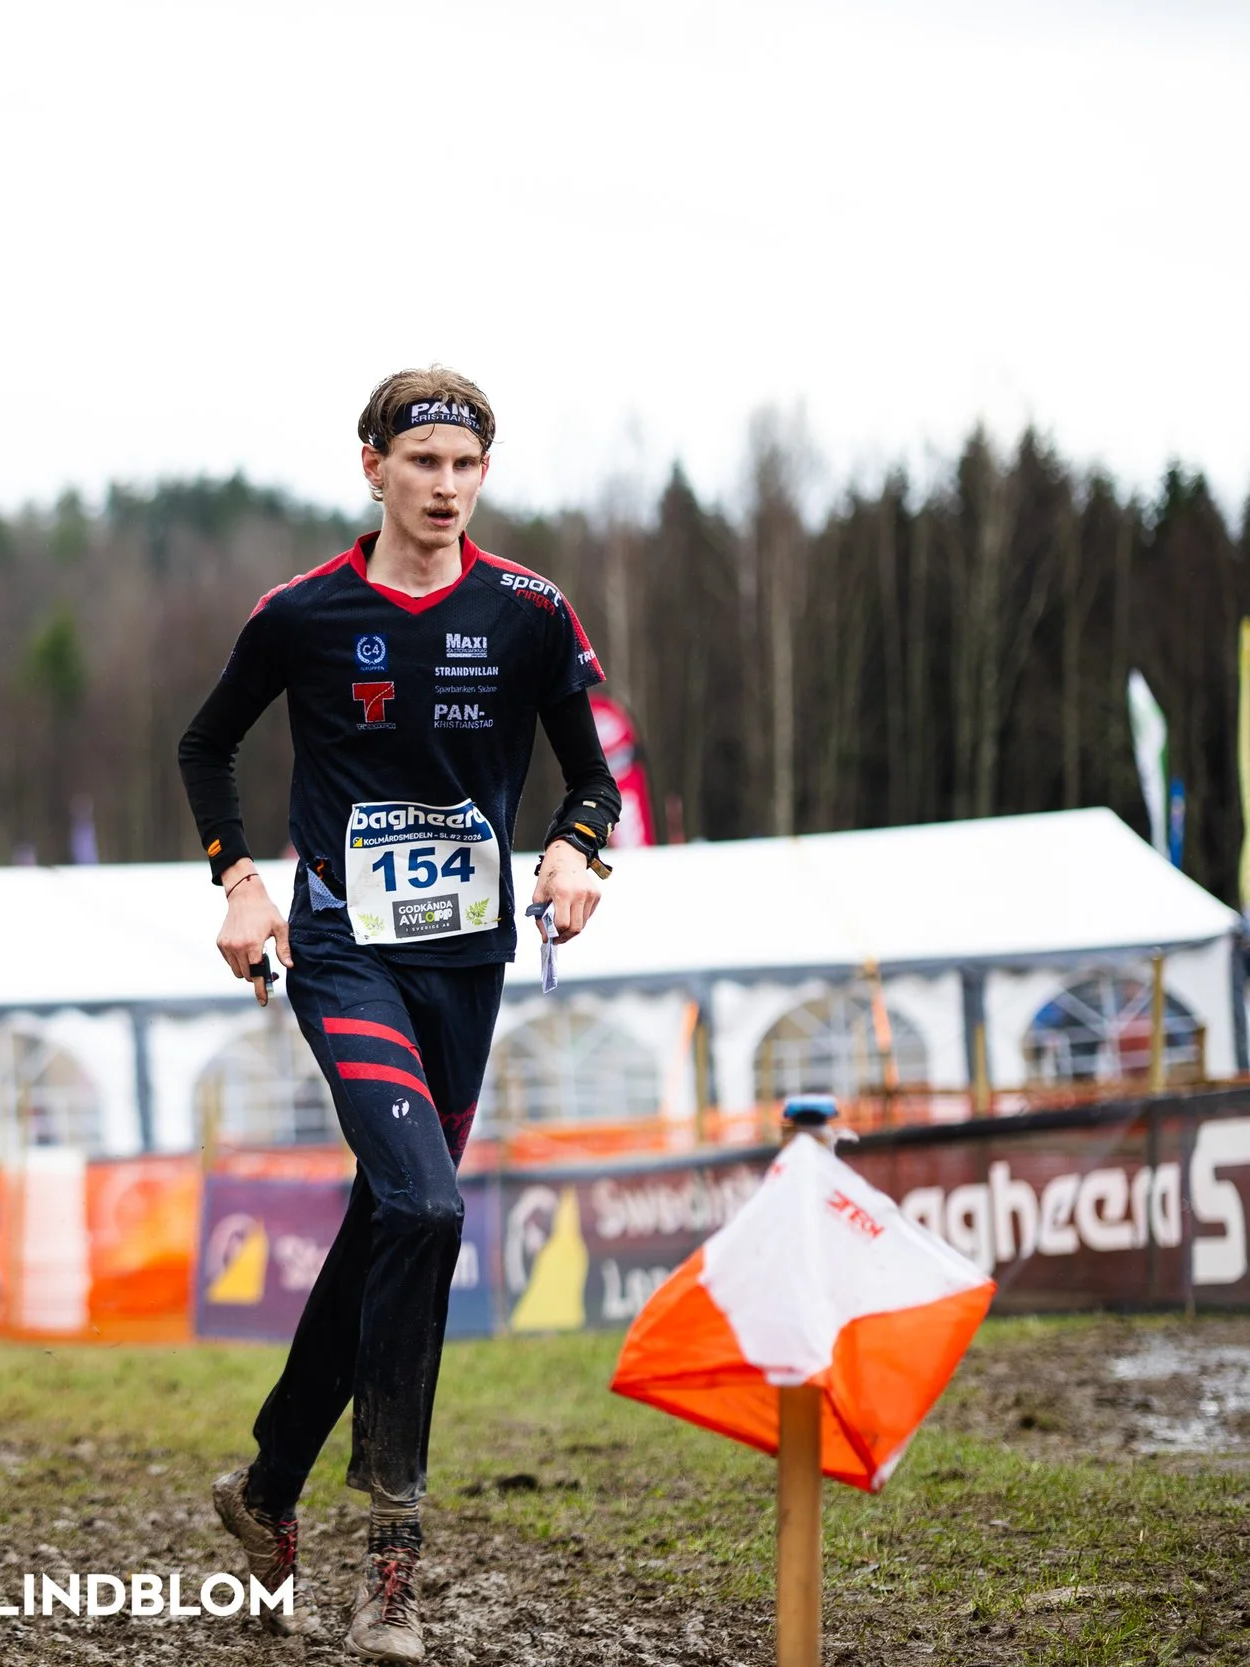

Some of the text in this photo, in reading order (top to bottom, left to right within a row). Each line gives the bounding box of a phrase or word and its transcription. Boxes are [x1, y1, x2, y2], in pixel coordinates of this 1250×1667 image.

[411, 402, 477, 418] PAN-
[411, 413, 480, 430] KRISTIANSTA
[500, 573, 562, 607] sport
[362, 644, 381, 656] C4
[434, 666, 499, 677] STRANDVILLAN
[434, 685, 476, 694] Sparbanken
[434, 704, 485, 720] PAN-
[433, 719, 494, 730] KRISTIANSTAD
[363, 831, 433, 847] KOLMÅRDSMEDELN
[450, 833, 461, 841] #2
[463, 833, 482, 842] 2026
[372, 847, 475, 892] 154
[398, 900, 453, 915] GODKÄNDA
[399, 908, 453, 926] AVLOPP
[901, 1160, 1183, 1278] agheera
